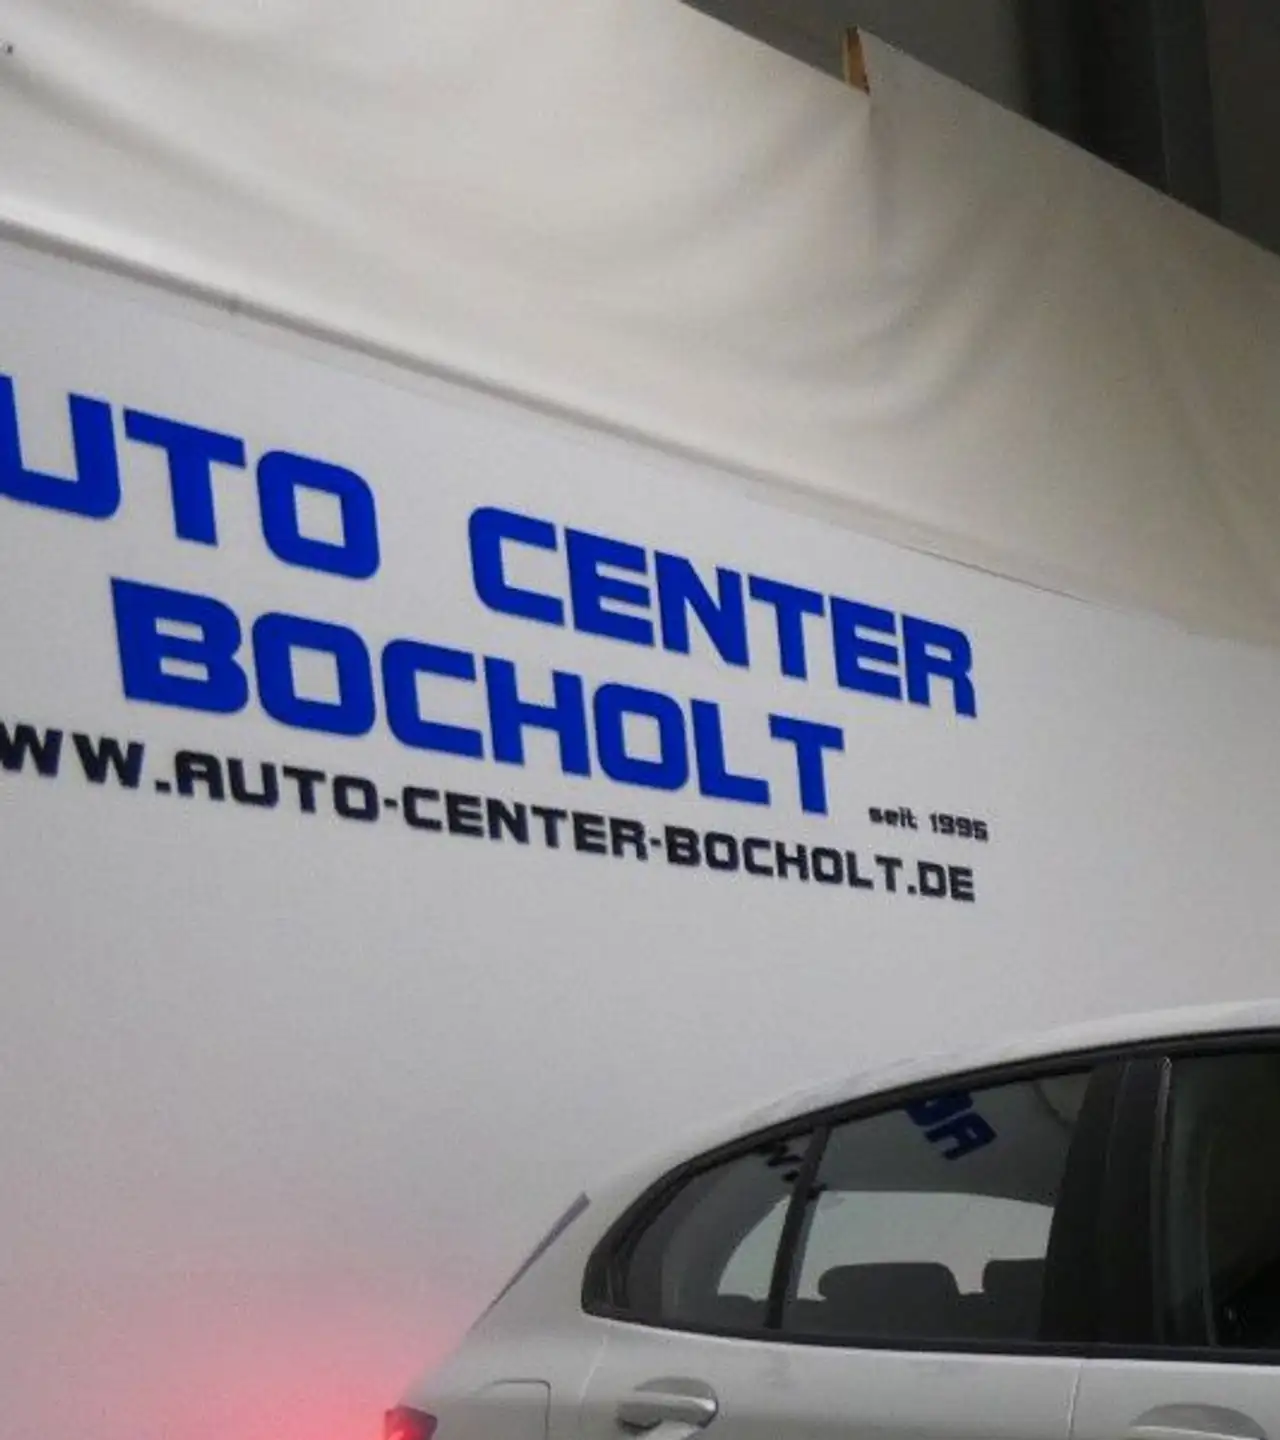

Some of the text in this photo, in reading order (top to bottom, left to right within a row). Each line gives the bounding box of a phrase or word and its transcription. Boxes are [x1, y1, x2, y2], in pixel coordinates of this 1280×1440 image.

[111, 576, 989, 842] BOCHOLT seit 1995
[468, 506, 977, 717] CENTER
